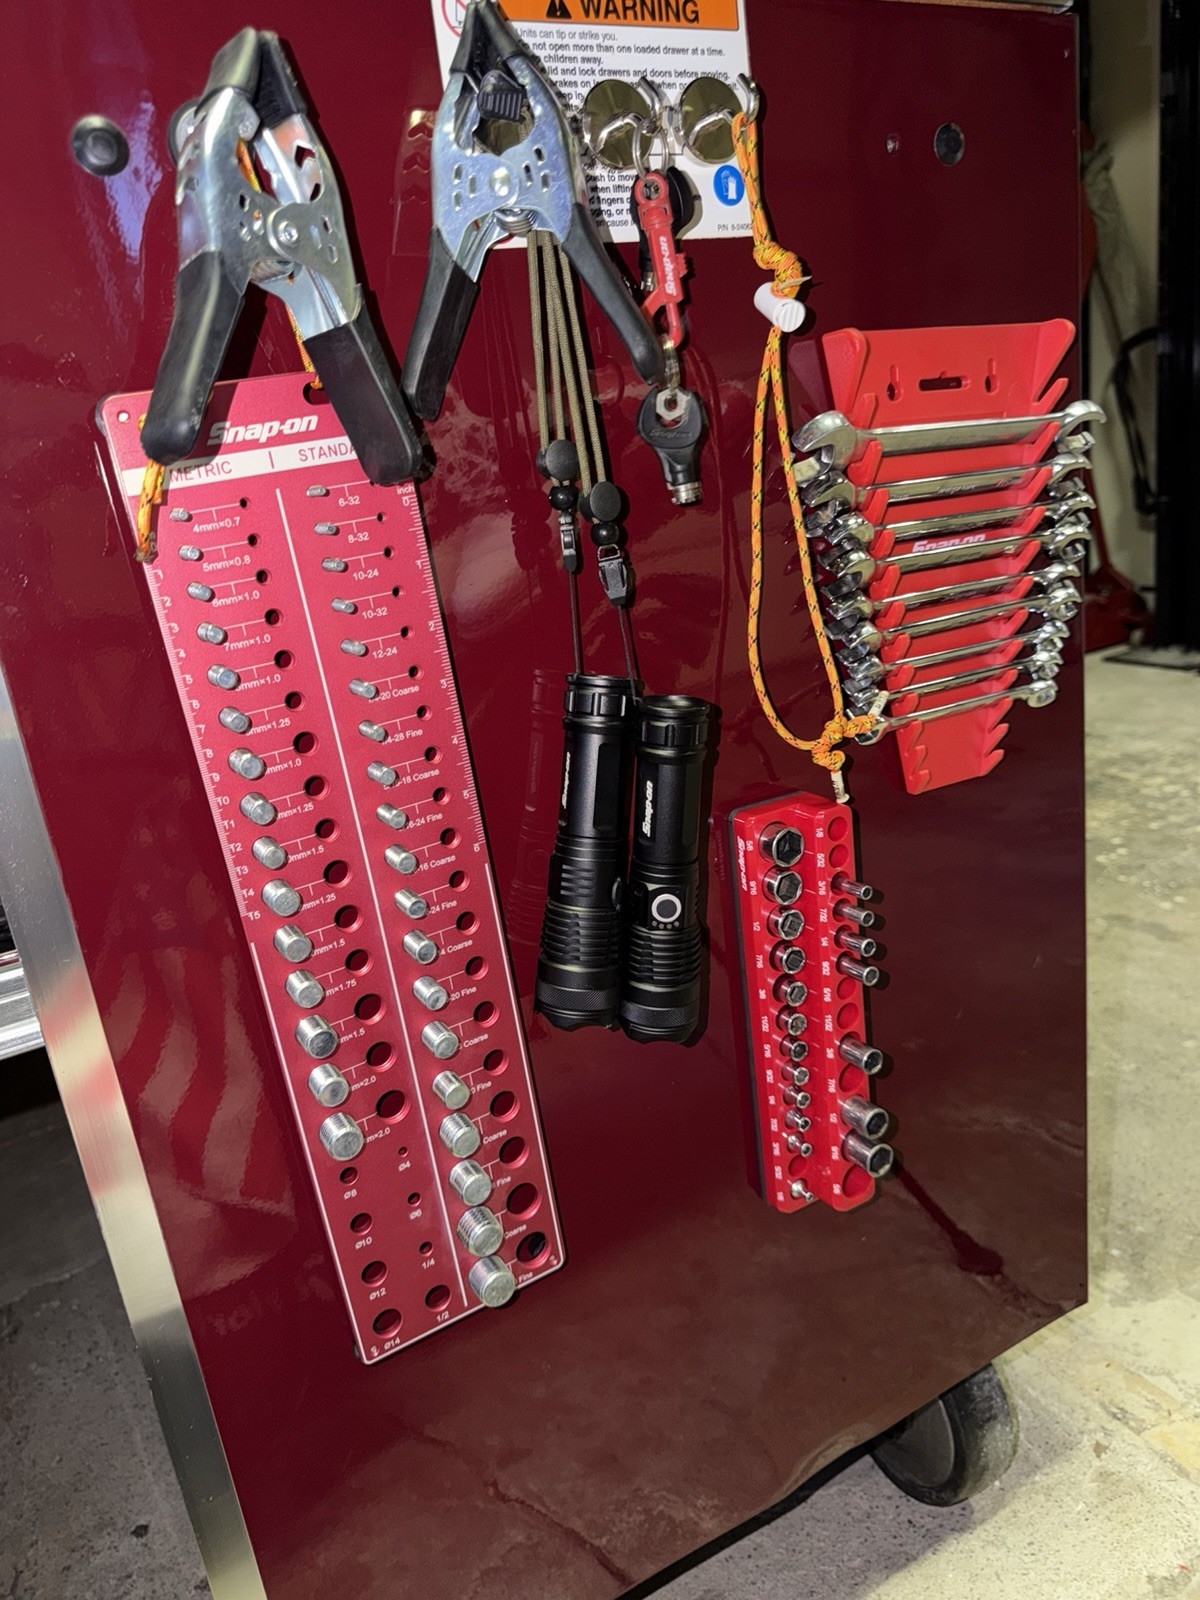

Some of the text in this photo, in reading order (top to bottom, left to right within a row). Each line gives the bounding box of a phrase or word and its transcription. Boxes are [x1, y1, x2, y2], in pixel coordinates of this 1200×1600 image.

[580, 0, 700, 24] WARNING
[539, 29, 555, 39] can
[556, 29, 567, 41] tip
[568, 31, 576, 40] or
[578, 30, 600, 41] strike
[601, 33, 618, 43] you.
[532, 42, 547, 51] not
[548, 43, 571, 53] open
[573, 43, 594, 53] more
[596, 43, 615, 53] than
[616, 45, 632, 54] one
[634, 44, 661, 55] loaded
[662, 45, 689, 56] drawer
[691, 46, 699, 56] at
[700, 48, 706, 56] a
[707, 46, 725, 57] time.
[544, 54, 579, 65] children
[580, 56, 604, 67] away.
[561, 66, 577, 77] and
[579, 67, 596, 77] lock
[598, 67, 631, 78] drawers
[633, 68, 648, 78] and
[650, 68, 672, 79] doors
[674, 69, 699, 80] before
[580, 81, 592, 90] on
[607, 174, 617, 182] to
[207, 414, 318, 446] Snap-on
[168, 460, 232, 483] METRIC
[338, 495, 360, 507] 6-32
[347, 532, 370, 544] 8-32
[353, 568, 380, 582] 10-24
[362, 606, 389, 621] 10-32
[372, 646, 398, 660] 12-24
[392, 685, 421, 698] Coarse
[405, 729, 424, 740] Fine
[412, 768, 441, 783] Coarse
[426, 813, 444, 824] Fine
[429, 854, 457, 869] Coarse
[441, 900, 459, 911] Fine
[446, 939, 474, 954] Coarse
[460, 986, 478, 998] Fine
[421, 1257, 436, 1270] 1/4
[436, 1310, 450, 1323] 1/2
